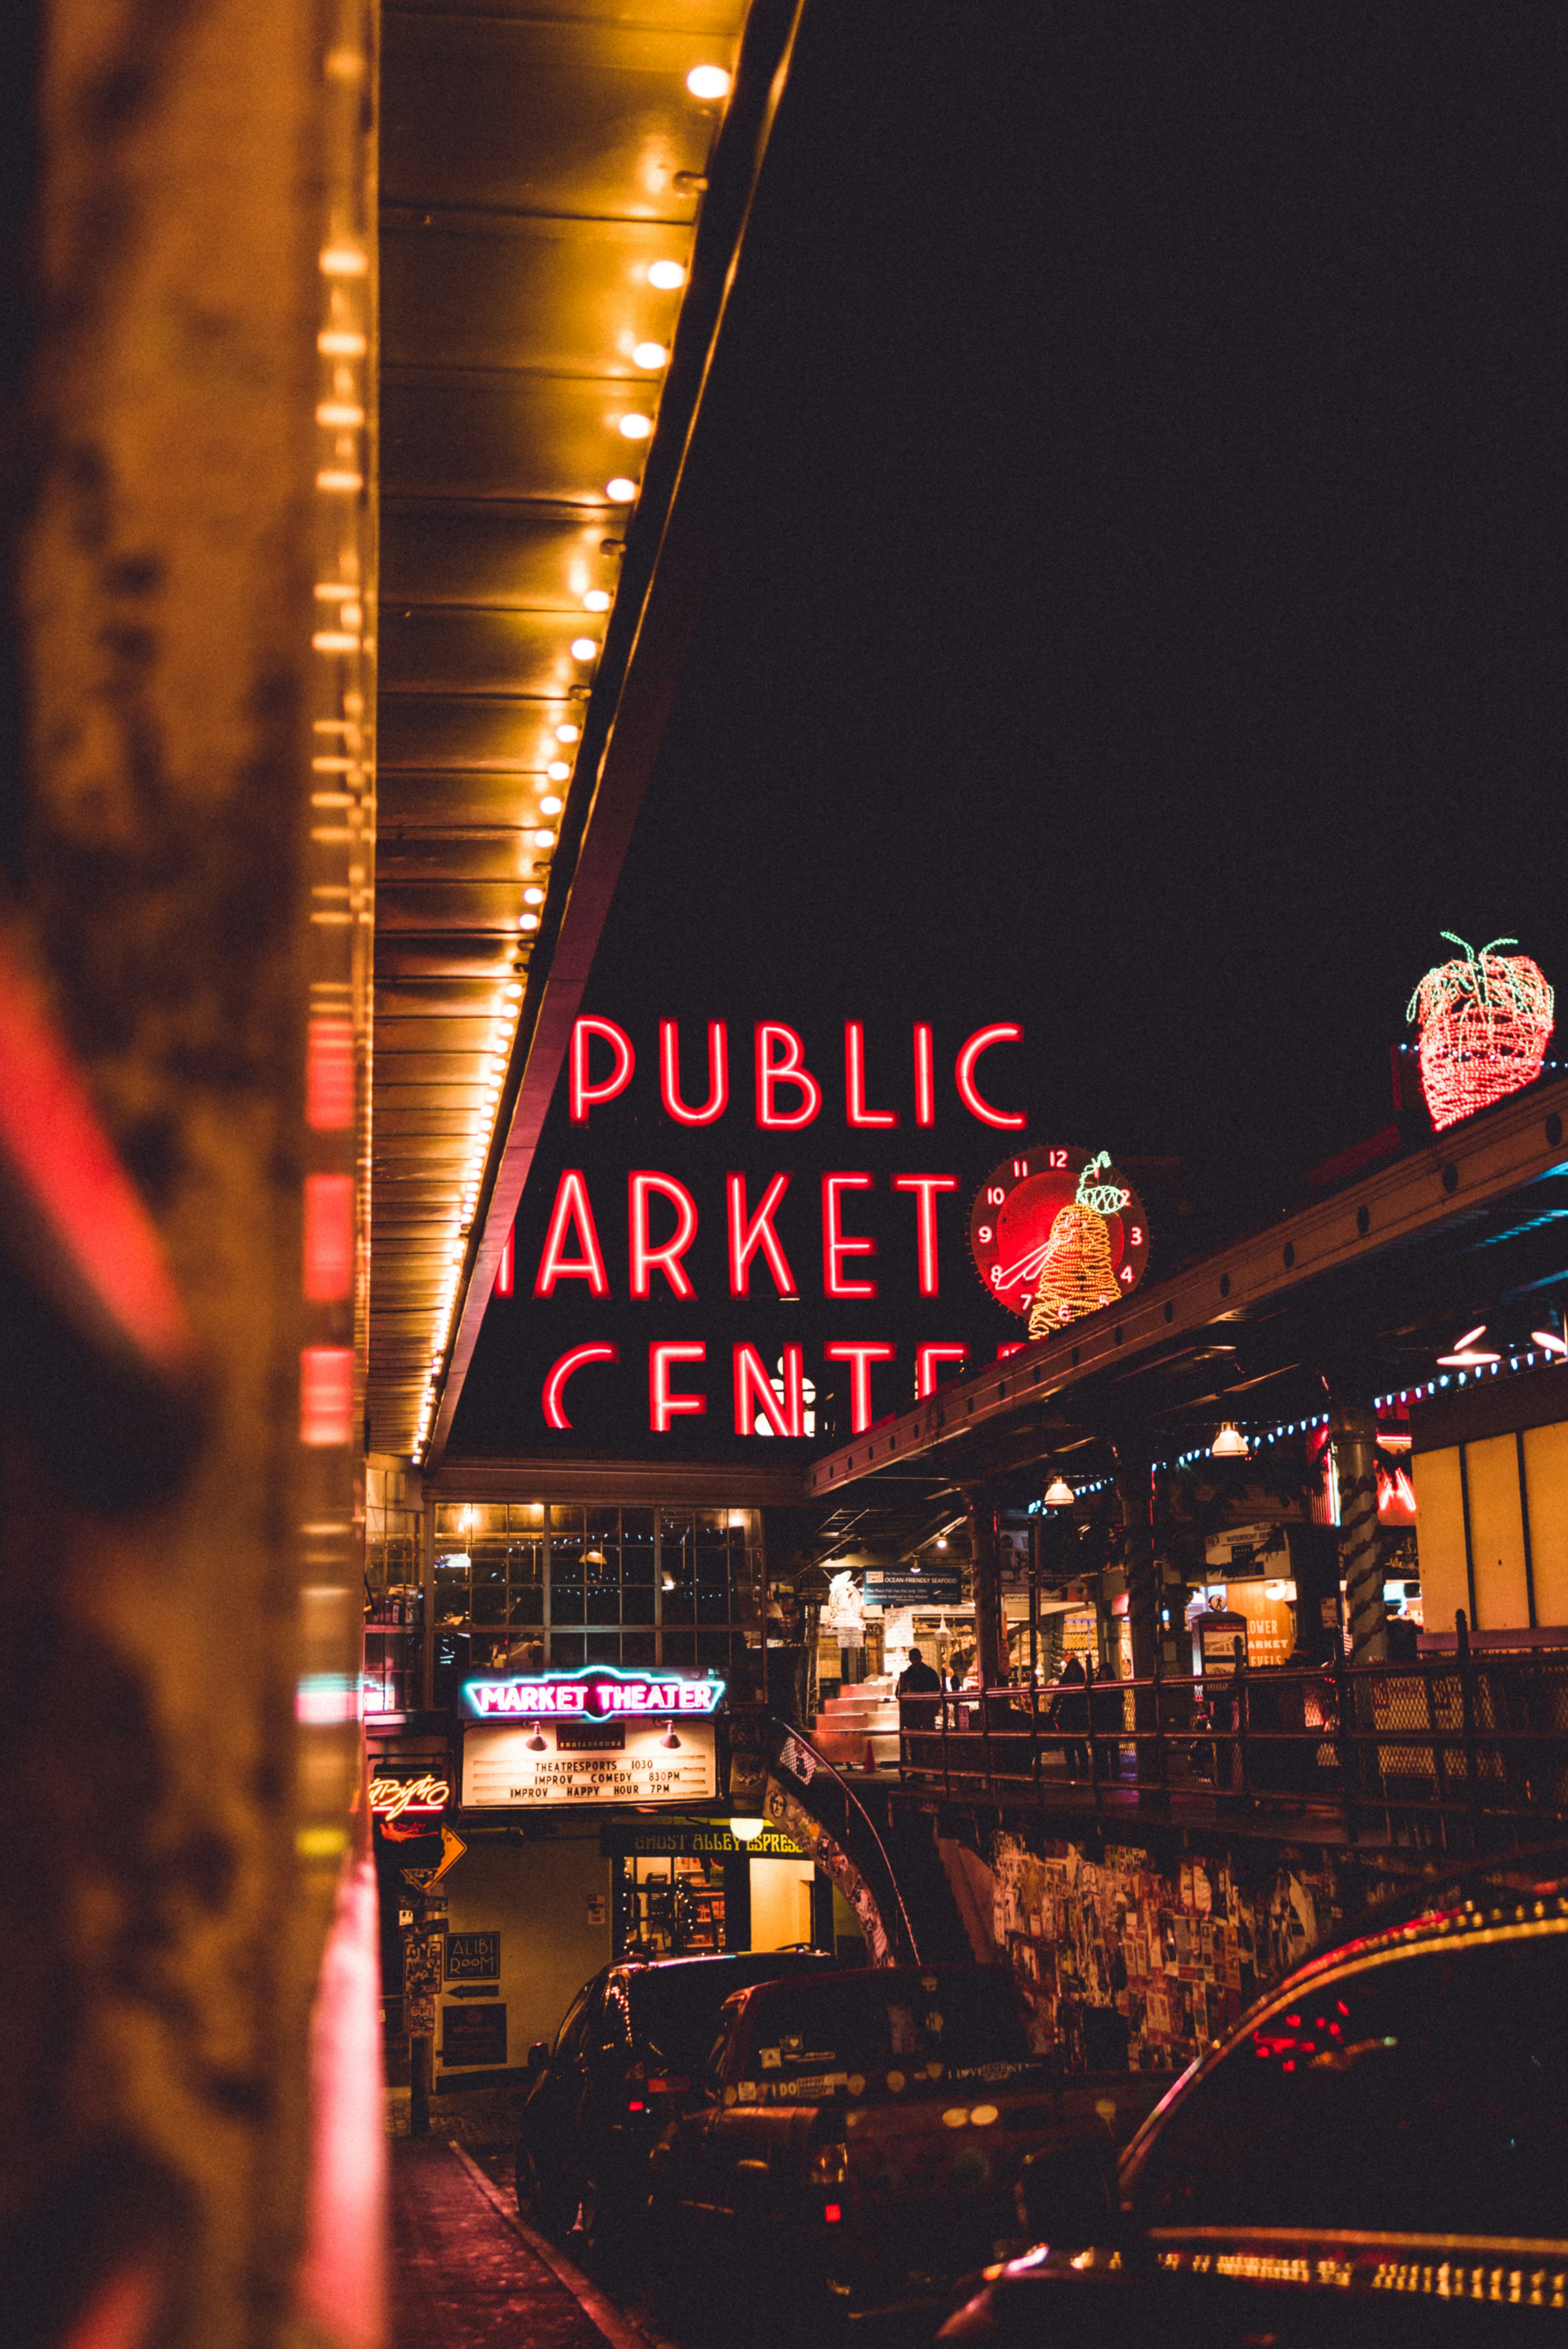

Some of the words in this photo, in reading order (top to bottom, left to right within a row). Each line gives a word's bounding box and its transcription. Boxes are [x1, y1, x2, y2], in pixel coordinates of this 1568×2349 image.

[570, 1014, 1028, 1131] PUBLIC
[1050, 1150, 1068, 1168] 12
[1014, 1160, 1029, 1178] 11
[987, 1186, 1006, 1205] 10
[978, 1225, 993, 1244] 9
[1130, 1227, 1143, 1246] 3
[990, 1265, 1003, 1283] 8
[1119, 1265, 1133, 1284] 4
[1020, 1294, 1034, 1310] 7
[1057, 1305, 1070, 1322] 6
[1247, 1620, 1278, 1634] OWER
[1247, 1639, 1288, 1649] ARKET
[481, 1685, 588, 1711] MARKET
[596, 1684, 712, 1710] THEATER
[536, 1761, 617, 1772] THEATRESPORTS
[632, 1760, 653, 1769] 1030
[535, 1774, 573, 1785] IMPROV
[591, 1773, 632, 1783] COMEDY
[649, 1771, 680, 1781] 830PM
[511, 1788, 548, 1798] IMPROV
[567, 1786, 600, 1796] HAPPY
[614, 1784, 639, 1795] HOUR
[651, 1784, 670, 1794] 7PM
[693, 1833, 740, 1851] ALLEY
[452, 1938, 494, 1955] ALIBI
[450, 1956, 494, 1975] ROOM
[779, 2081, 797, 2097] DO
